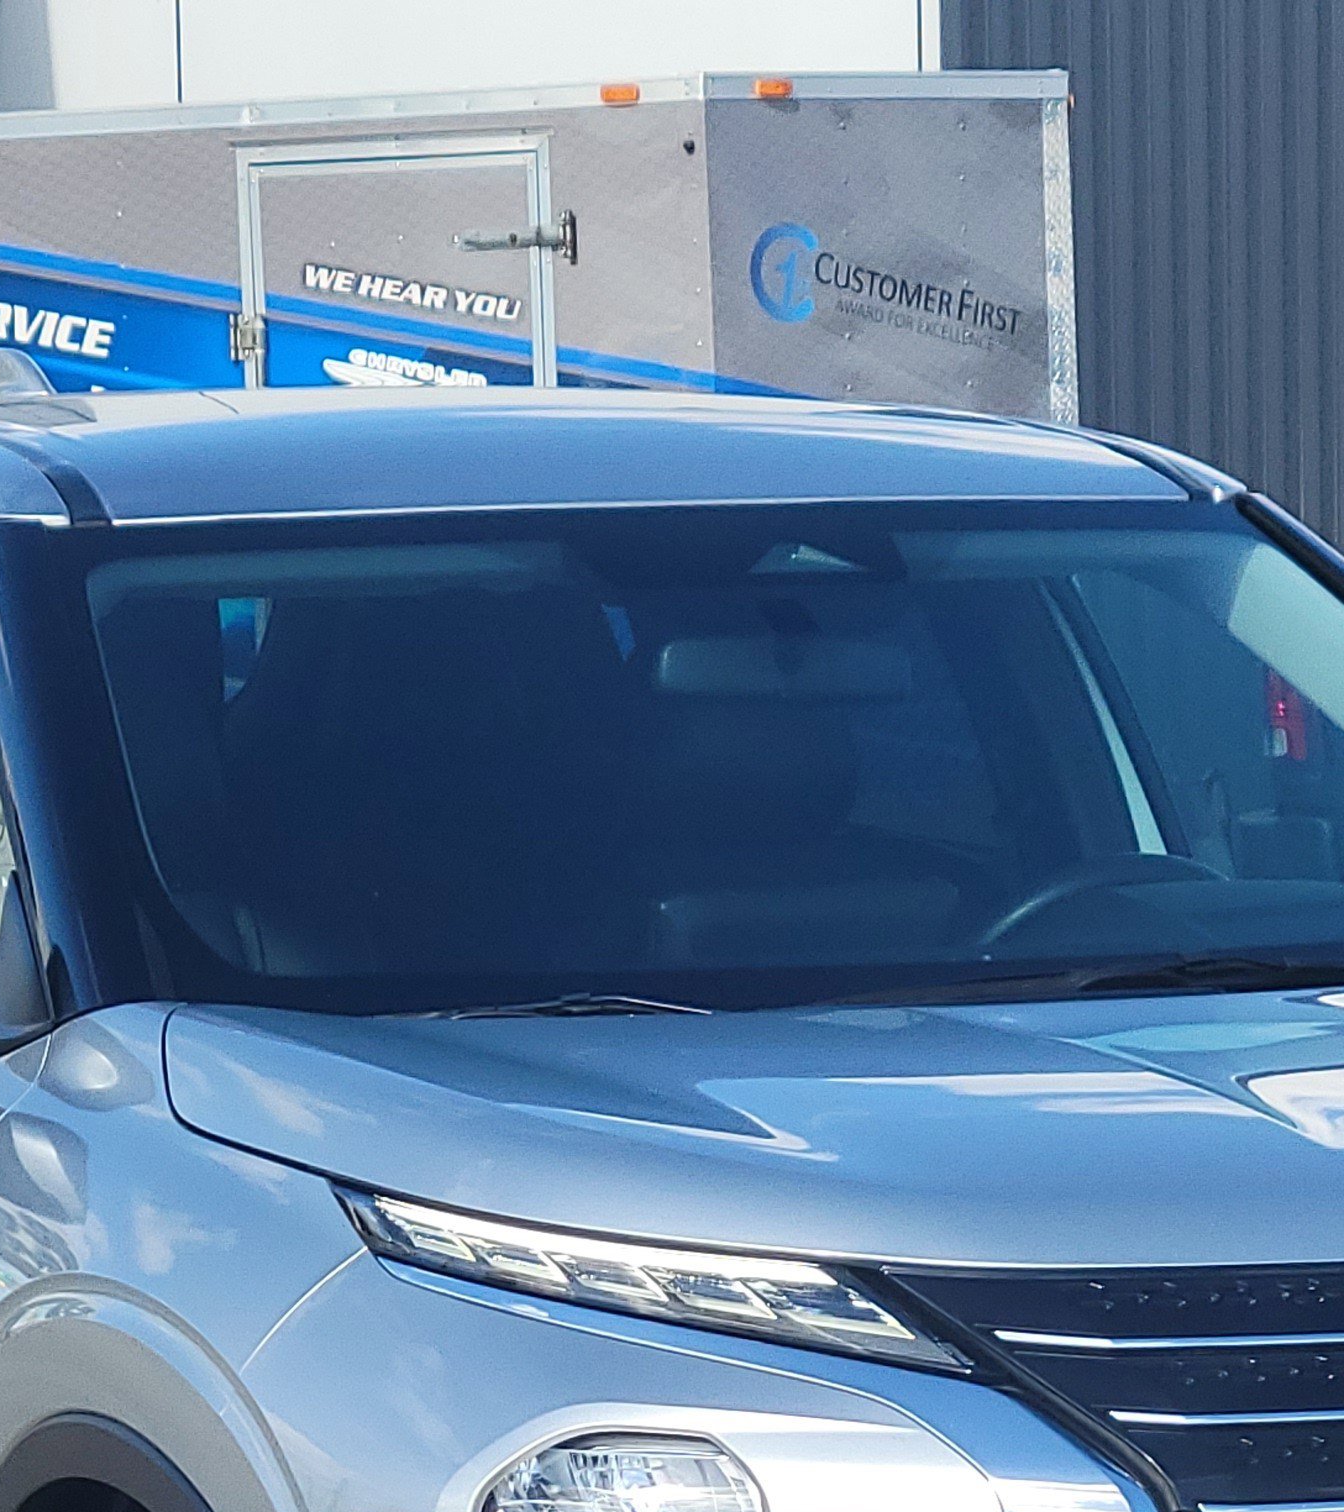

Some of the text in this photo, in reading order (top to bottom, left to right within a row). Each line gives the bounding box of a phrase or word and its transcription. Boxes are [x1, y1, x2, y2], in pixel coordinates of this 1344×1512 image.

[305, 264, 522, 320] WE HEAR YOU
[814, 251, 1022, 336] CUSTOMER FIRST
[835, 299, 884, 324] AWARD
[887, 309, 914, 332] FOR
